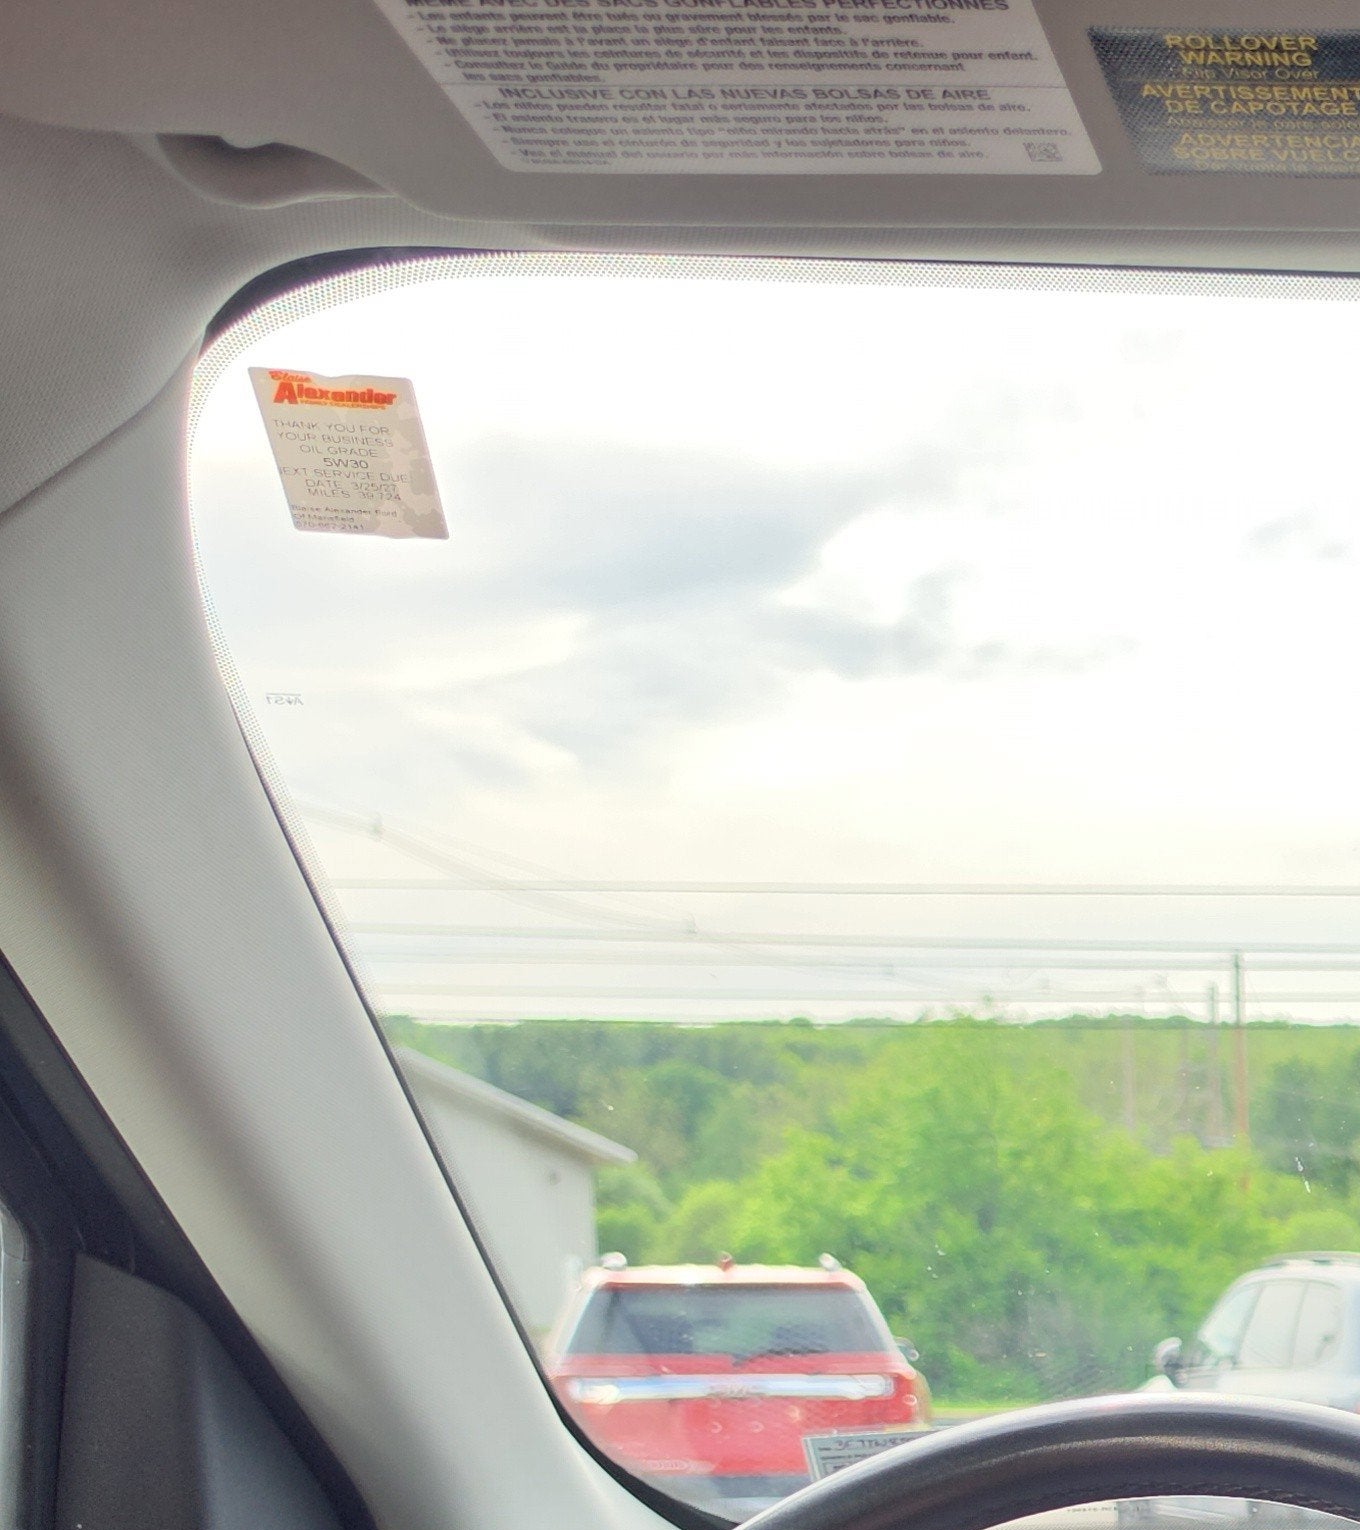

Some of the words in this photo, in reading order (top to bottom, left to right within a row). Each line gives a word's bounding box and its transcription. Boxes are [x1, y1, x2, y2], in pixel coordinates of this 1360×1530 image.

[1164, 35, 1319, 51] ROLLOVER
[1179, 51, 1313, 67] WARNING
[1275, 68, 1320, 79] Over
[497, 89, 616, 99] INCLUSIVE
[619, 89, 668, 99] CON
[671, 89, 716, 99] LAS
[720, 89, 807, 99] NUEVAS
[812, 89, 900, 99] BOLSAS
[905, 89, 936, 99] DE
[941, 89, 992, 99] AIRE
[1166, 100, 1204, 114] DE
[1211, 102, 1358, 116] CAPOTAGE
[273, 382, 397, 405] Alexander
[273, 419, 318, 430] THANK
[327, 423, 356, 433] YOU
[360, 425, 390, 435] FOR
[276, 432, 316, 441] YOUR
[321, 434, 394, 447] BUSINESS
[300, 444, 323, 454] OIL
[327, 446, 379, 458] GRADE
[323, 457, 369, 469] 5W30
[305, 478, 341, 489] DATE
[313, 468, 374, 480] SERVICE
[379, 472, 408, 484] DUE
[306, 488, 350, 498] MILES
